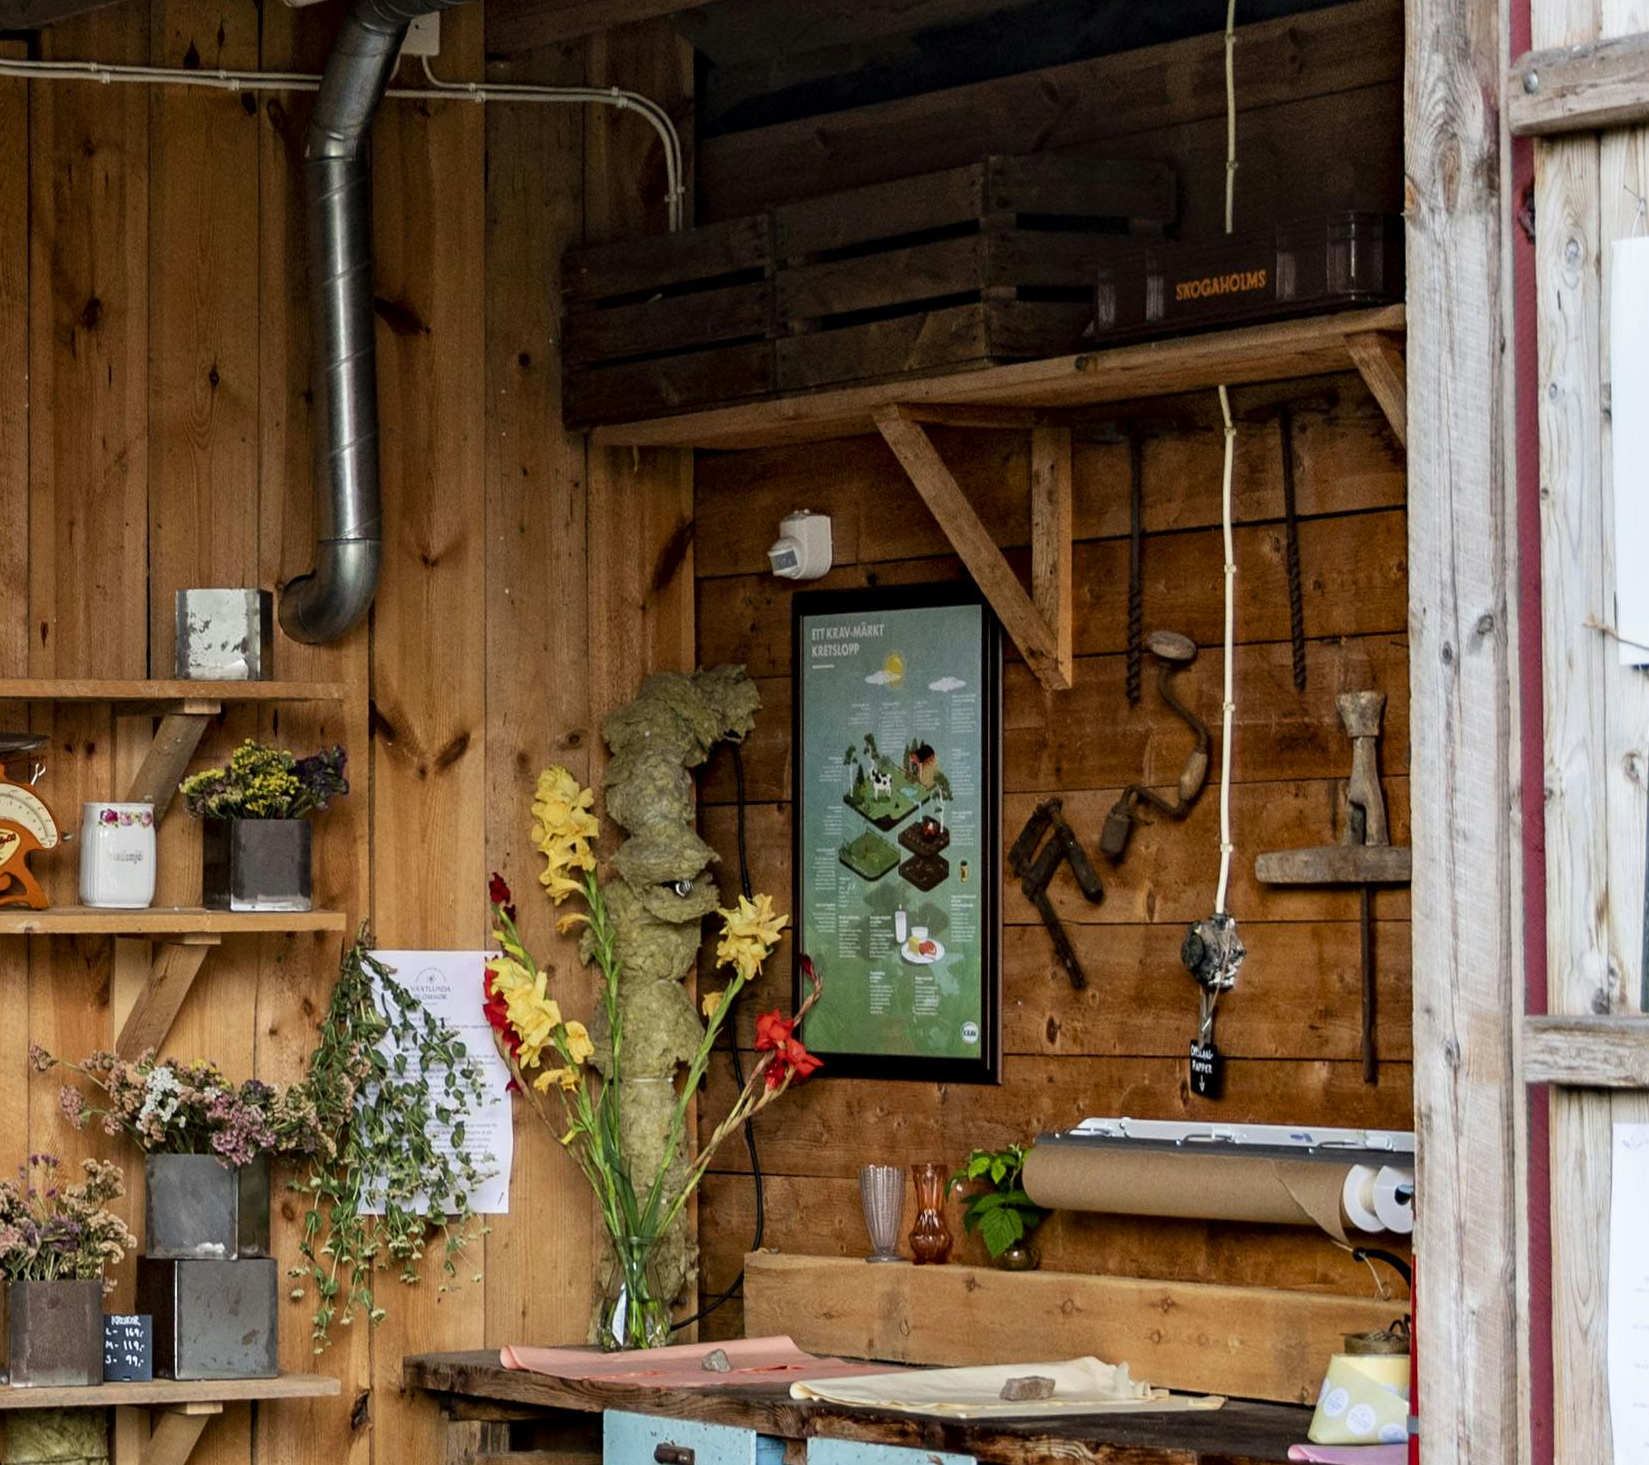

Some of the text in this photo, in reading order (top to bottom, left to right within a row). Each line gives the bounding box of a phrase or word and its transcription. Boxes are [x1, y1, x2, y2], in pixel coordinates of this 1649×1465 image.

[1175, 269, 1266, 301] SKOGAHOLMS
[811, 622, 885, 641] ETT KRAV-MÄRKT
[811, 643, 860, 658] KRETSLOPP
